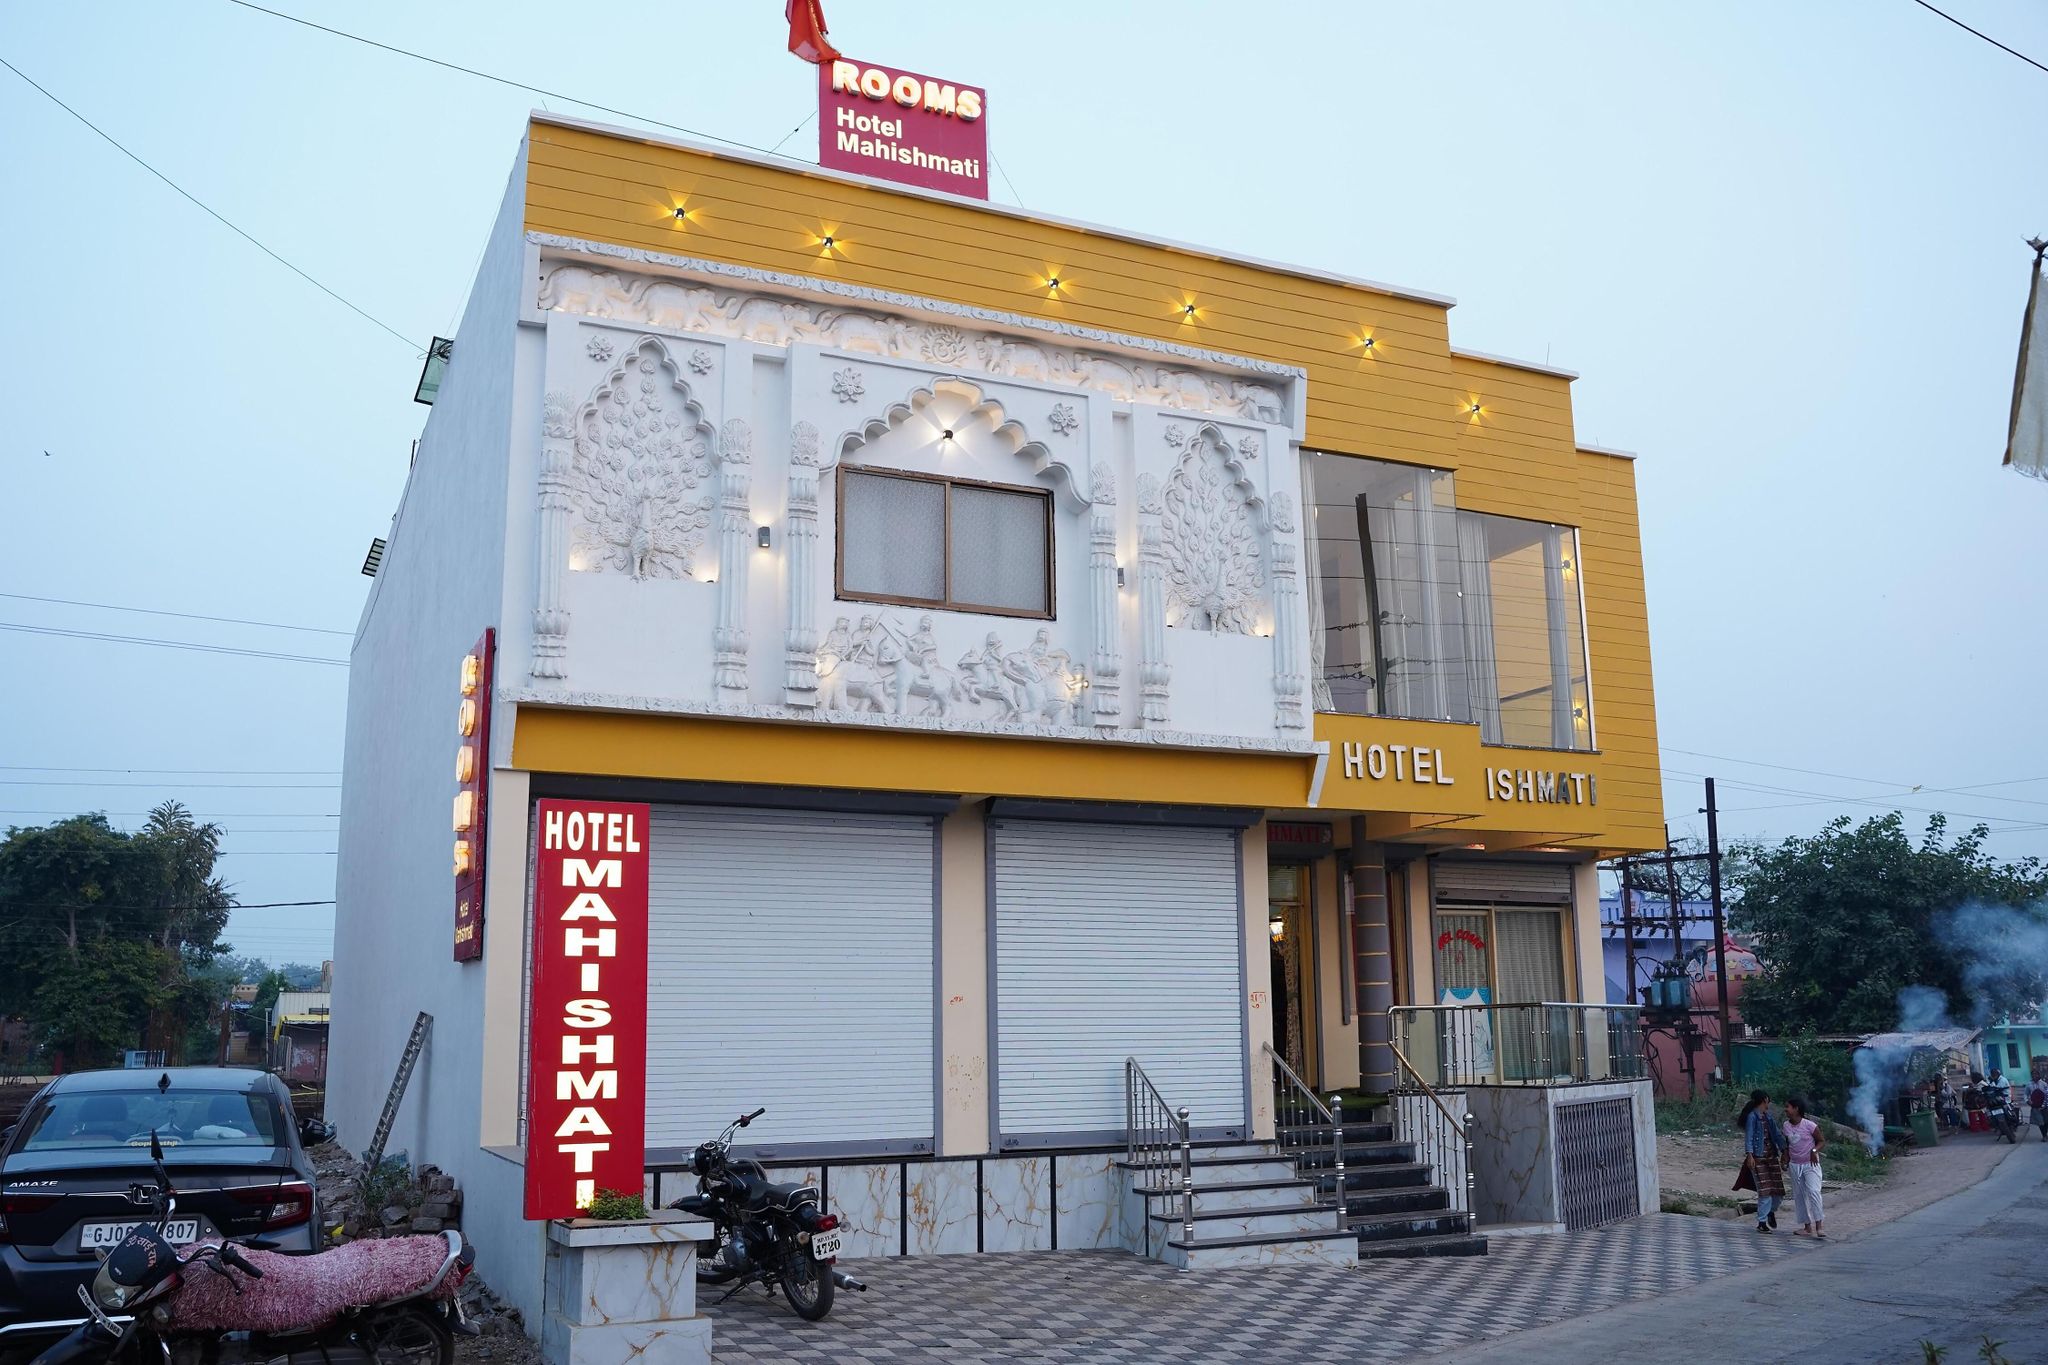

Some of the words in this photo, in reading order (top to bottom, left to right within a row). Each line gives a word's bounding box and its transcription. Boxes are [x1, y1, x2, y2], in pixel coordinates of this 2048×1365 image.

[832, 60, 982, 121] ROOMS
[836, 107, 903, 138] Hotel
[837, 131, 980, 178] Mahishmati
[1343, 741, 1454, 785] HOTEL
[1485, 767, 1597, 805] ISHMATI
[545, 810, 640, 853] HOTEL
[554, 858, 622, 1210] MAHISHMATI
[815, 1239, 841, 1256] 4720
